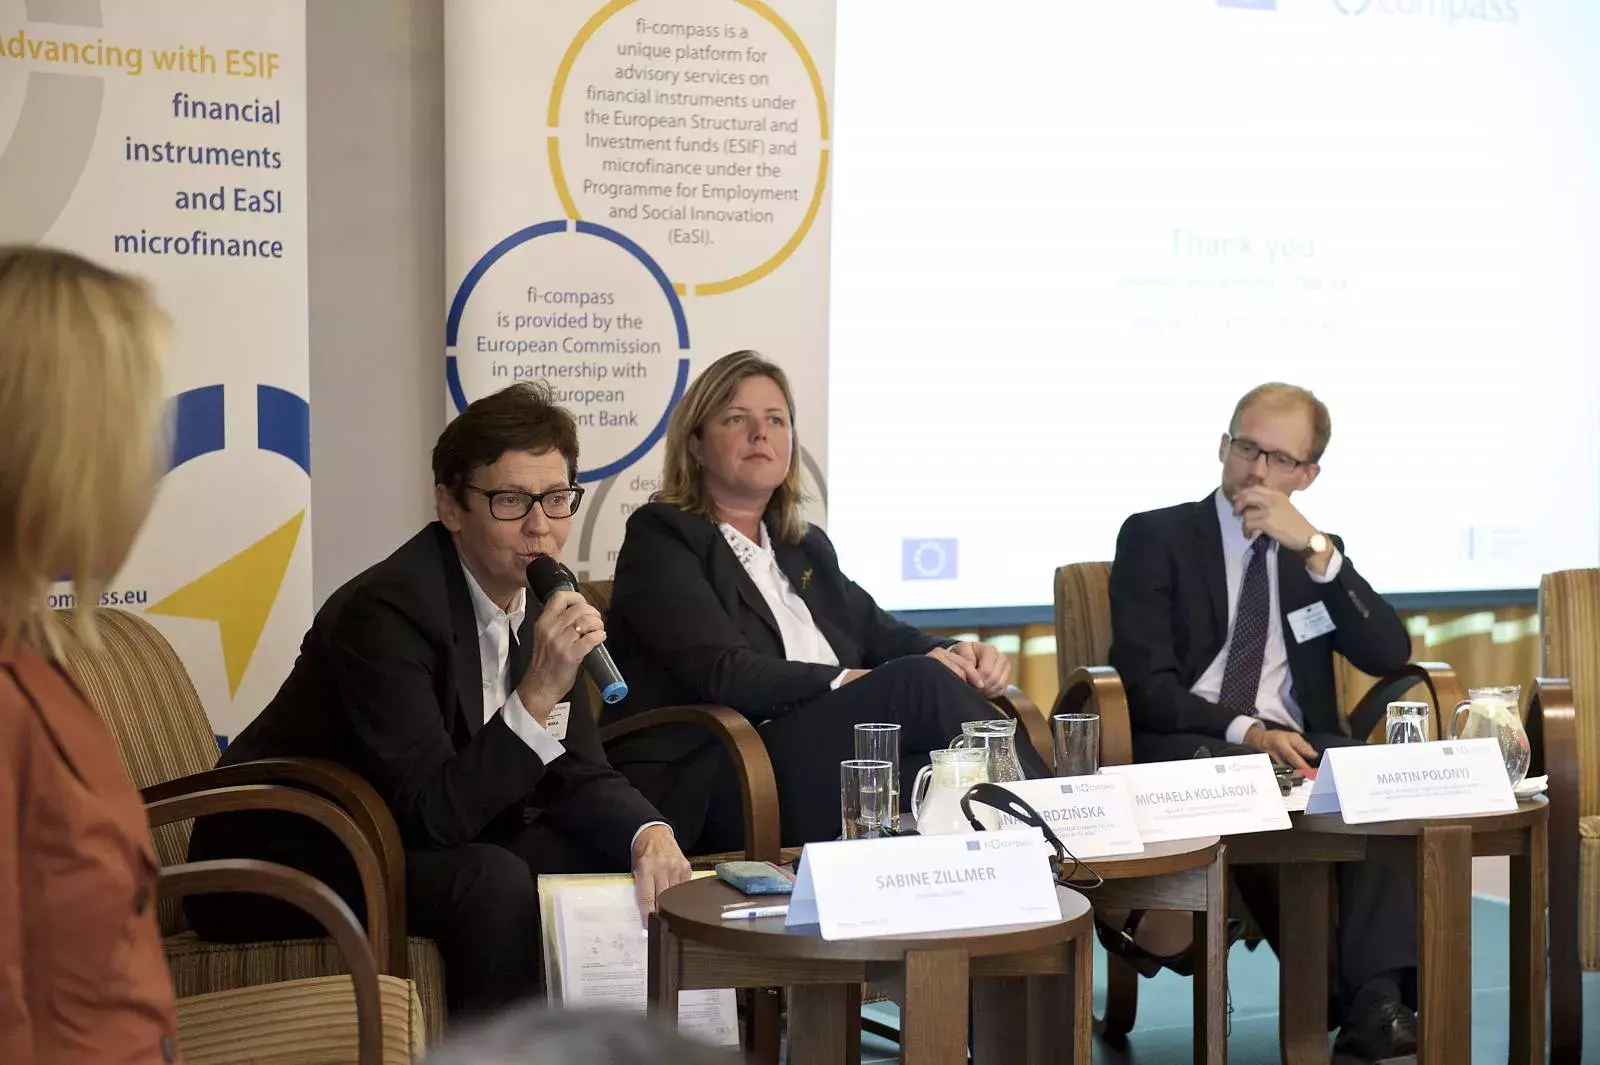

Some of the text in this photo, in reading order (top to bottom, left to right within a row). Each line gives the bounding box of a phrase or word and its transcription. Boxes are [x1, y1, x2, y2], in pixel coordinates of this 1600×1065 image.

[636, 18, 748, 40] fi-compass is a
[152, 48, 216, 74] with
[226, 49, 279, 79] ESIF
[617, 43, 767, 63] unique platform for
[615, 65, 768, 86] advisory services on
[172, 93, 280, 124] financial
[587, 86, 796, 110] financial instruments under
[585, 110, 798, 133] the European Structural and
[126, 137, 282, 169] instruments
[585, 133, 797, 156] Investment funds (ESIF) and
[603, 157, 781, 178] microfinance under the
[176, 187, 282, 214] and EaSI
[584, 179, 799, 203] Programme for Employment
[609, 205, 774, 223] and Social Innovation
[114, 229, 283, 258] microfinance
[668, 228, 714, 246] (EaSI).
[1169, 227, 1317, 265] Thank you
[527, 286, 615, 308] fi-compass
[497, 312, 643, 332] is provided by the
[476, 336, 661, 356] European Commission
[492, 362, 647, 381] in partnership with
[549, 386, 624, 406] European
[599, 411, 638, 427] Bank
[1377, 770, 1421, 785] MARTIN
[1135, 789, 1193, 806] MICHAELA
[876, 866, 996, 890] SABINE ZILLMER
